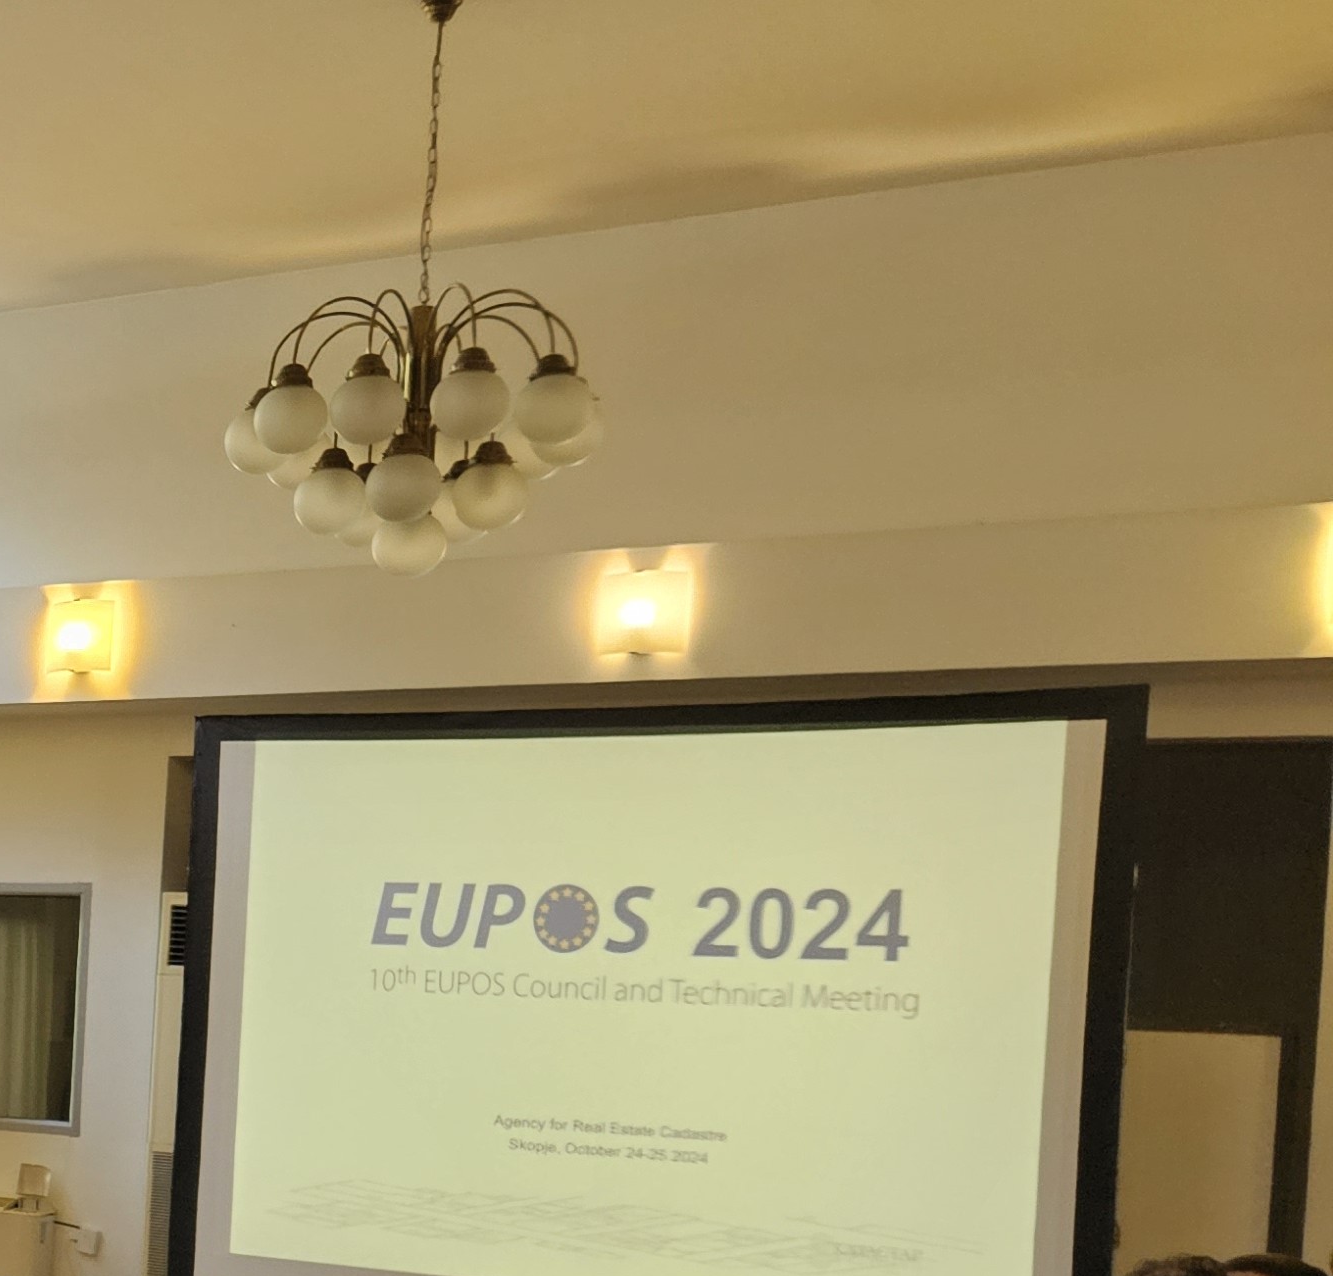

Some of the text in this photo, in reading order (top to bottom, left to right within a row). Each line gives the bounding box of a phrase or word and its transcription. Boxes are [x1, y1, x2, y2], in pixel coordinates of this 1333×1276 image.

[371, 881, 910, 962] EUPOS 2024
[370, 965, 921, 1020] 10th EUPOS Council and Technical Meeting
[493, 1114, 728, 1142] Agency for Real Estate Cadastre
[565, 1142, 622, 1158] October
[671, 1150, 709, 1164] 2024
